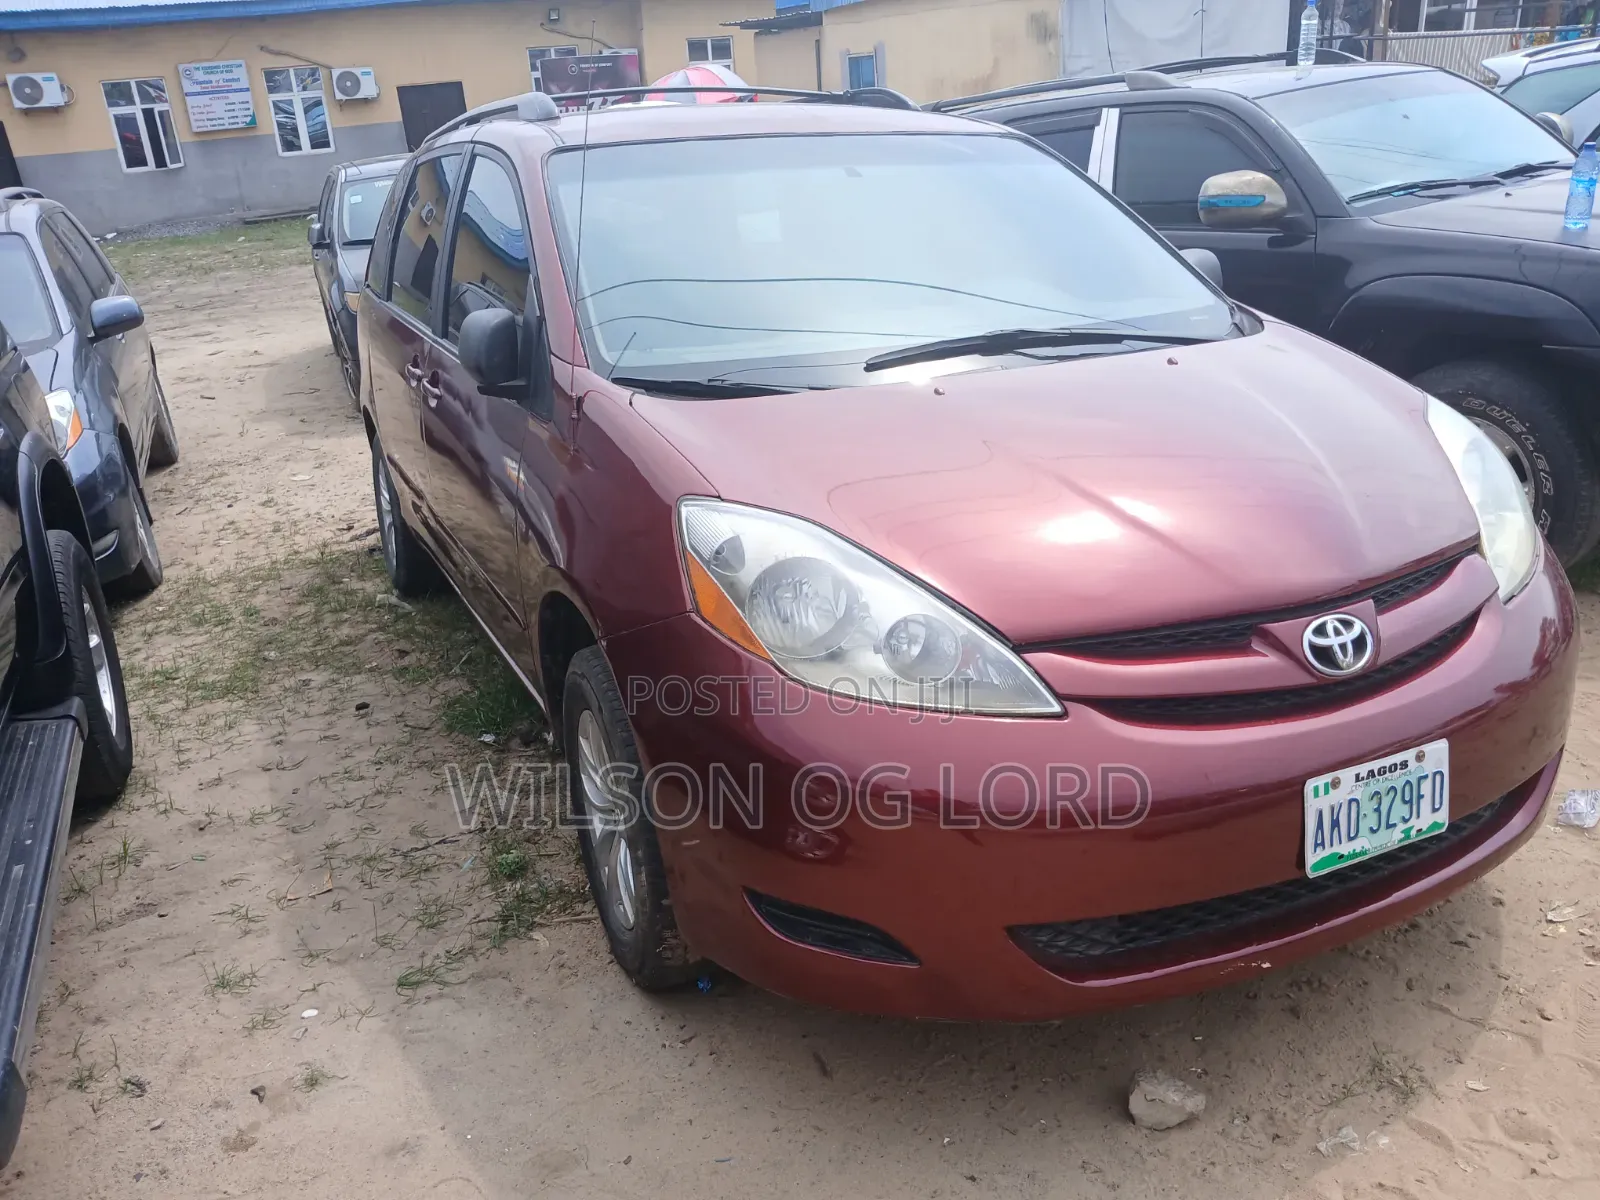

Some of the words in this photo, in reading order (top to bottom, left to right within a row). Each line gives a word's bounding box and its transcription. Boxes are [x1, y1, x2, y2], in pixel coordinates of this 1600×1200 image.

[1462, 397, 1554, 496] DUELER
[1354, 759, 1409, 784] LAGOS
[1350, 781, 1372, 792] CENTRE
